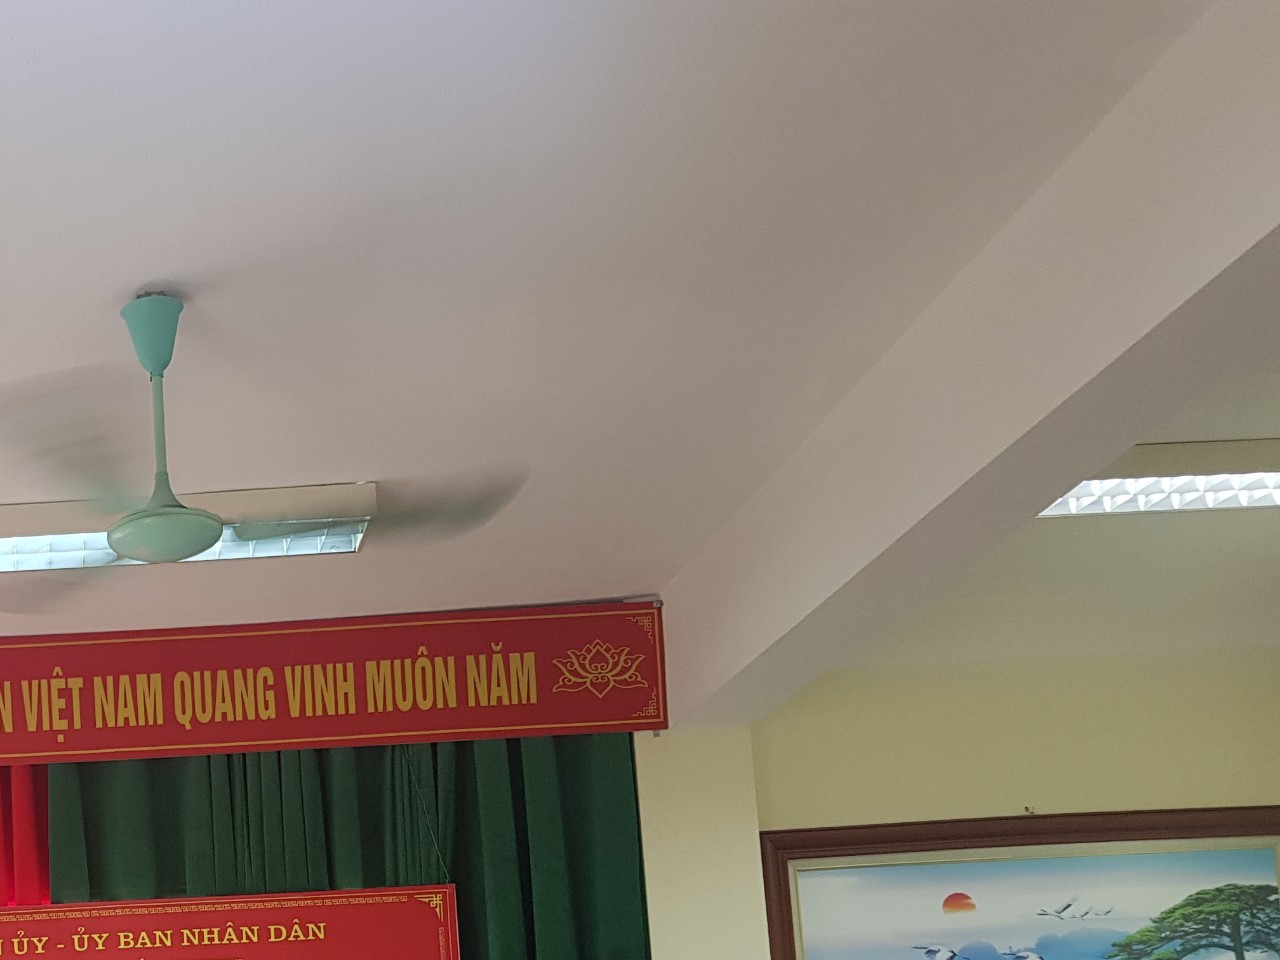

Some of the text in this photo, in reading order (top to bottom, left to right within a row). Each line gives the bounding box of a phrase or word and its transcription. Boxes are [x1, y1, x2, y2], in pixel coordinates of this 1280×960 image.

[21, 667, 83, 742] VIỆT
[93, 673, 163, 729] NAM
[174, 667, 276, 730] QUANG
[284, 662, 355, 717] VINH
[366, 646, 456, 713] MUÔN
[466, 642, 538, 707] NĂM
[12, 931, 49, 956] ỦY
[73, 927, 109, 952] ỦY
[118, 930, 172, 949] BAN
[181, 922, 259, 946] NHÂN
[268, 919, 326, 942] DÂN
